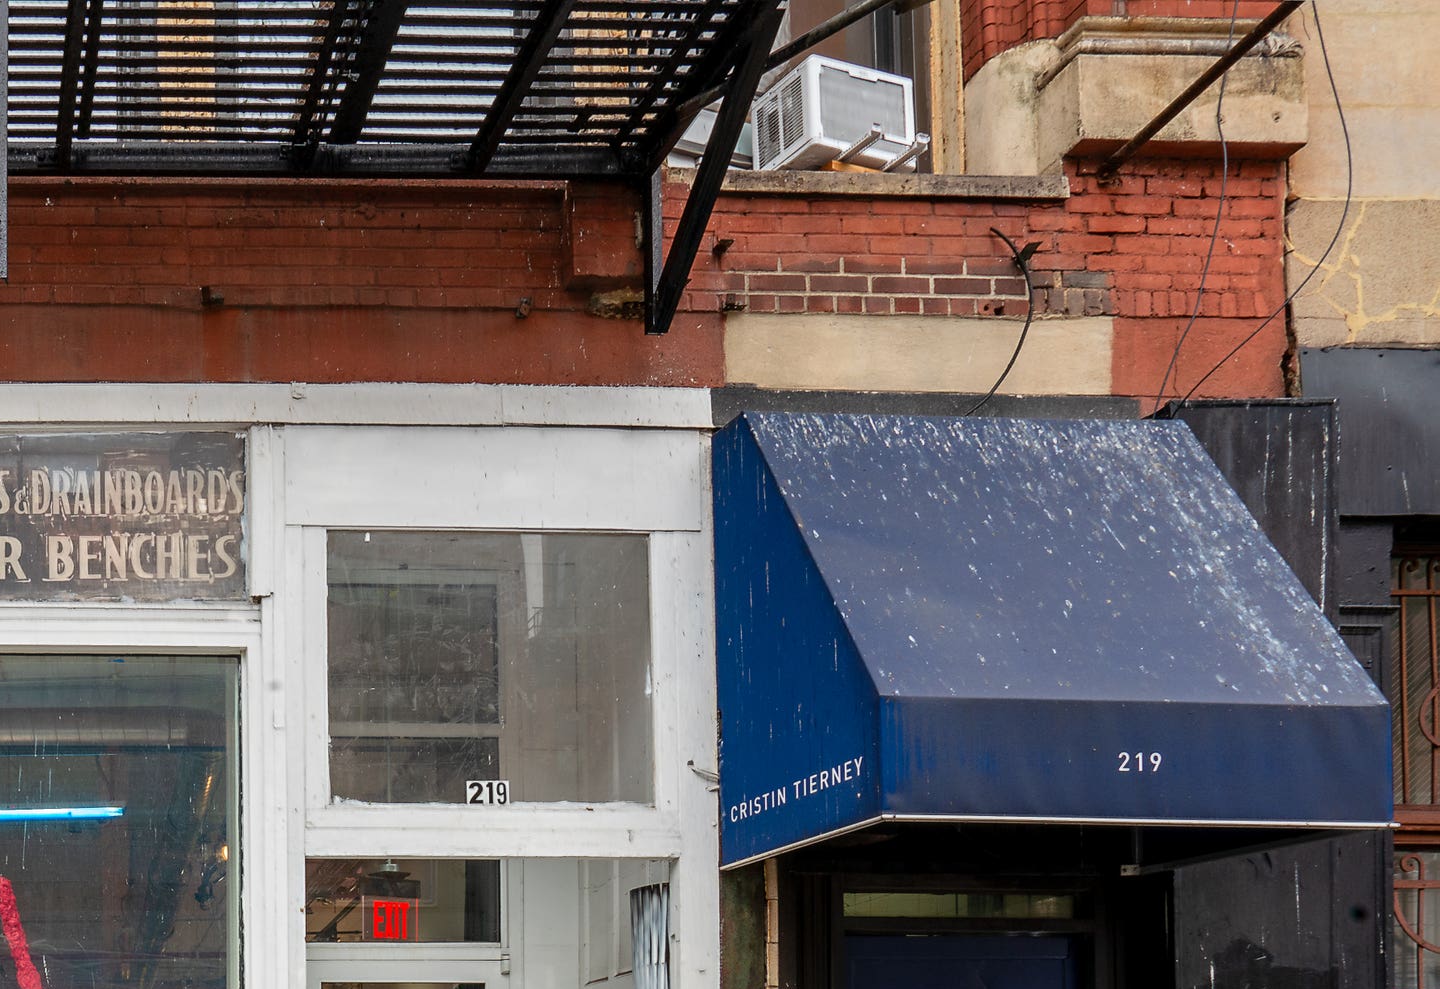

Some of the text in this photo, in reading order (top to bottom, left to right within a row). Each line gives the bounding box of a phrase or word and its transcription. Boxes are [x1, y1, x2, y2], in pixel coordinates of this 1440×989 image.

[14, 488, 30, 515] &
[31, 468, 244, 515] DRAINBOARDS
[48, 534, 237, 581] BENCHES
[1118, 751, 1162, 772] 219
[468, 782, 507, 805] 219
[730, 756, 863, 823] CRISTIN TIERNEY
[373, 900, 410, 940] EXIT
